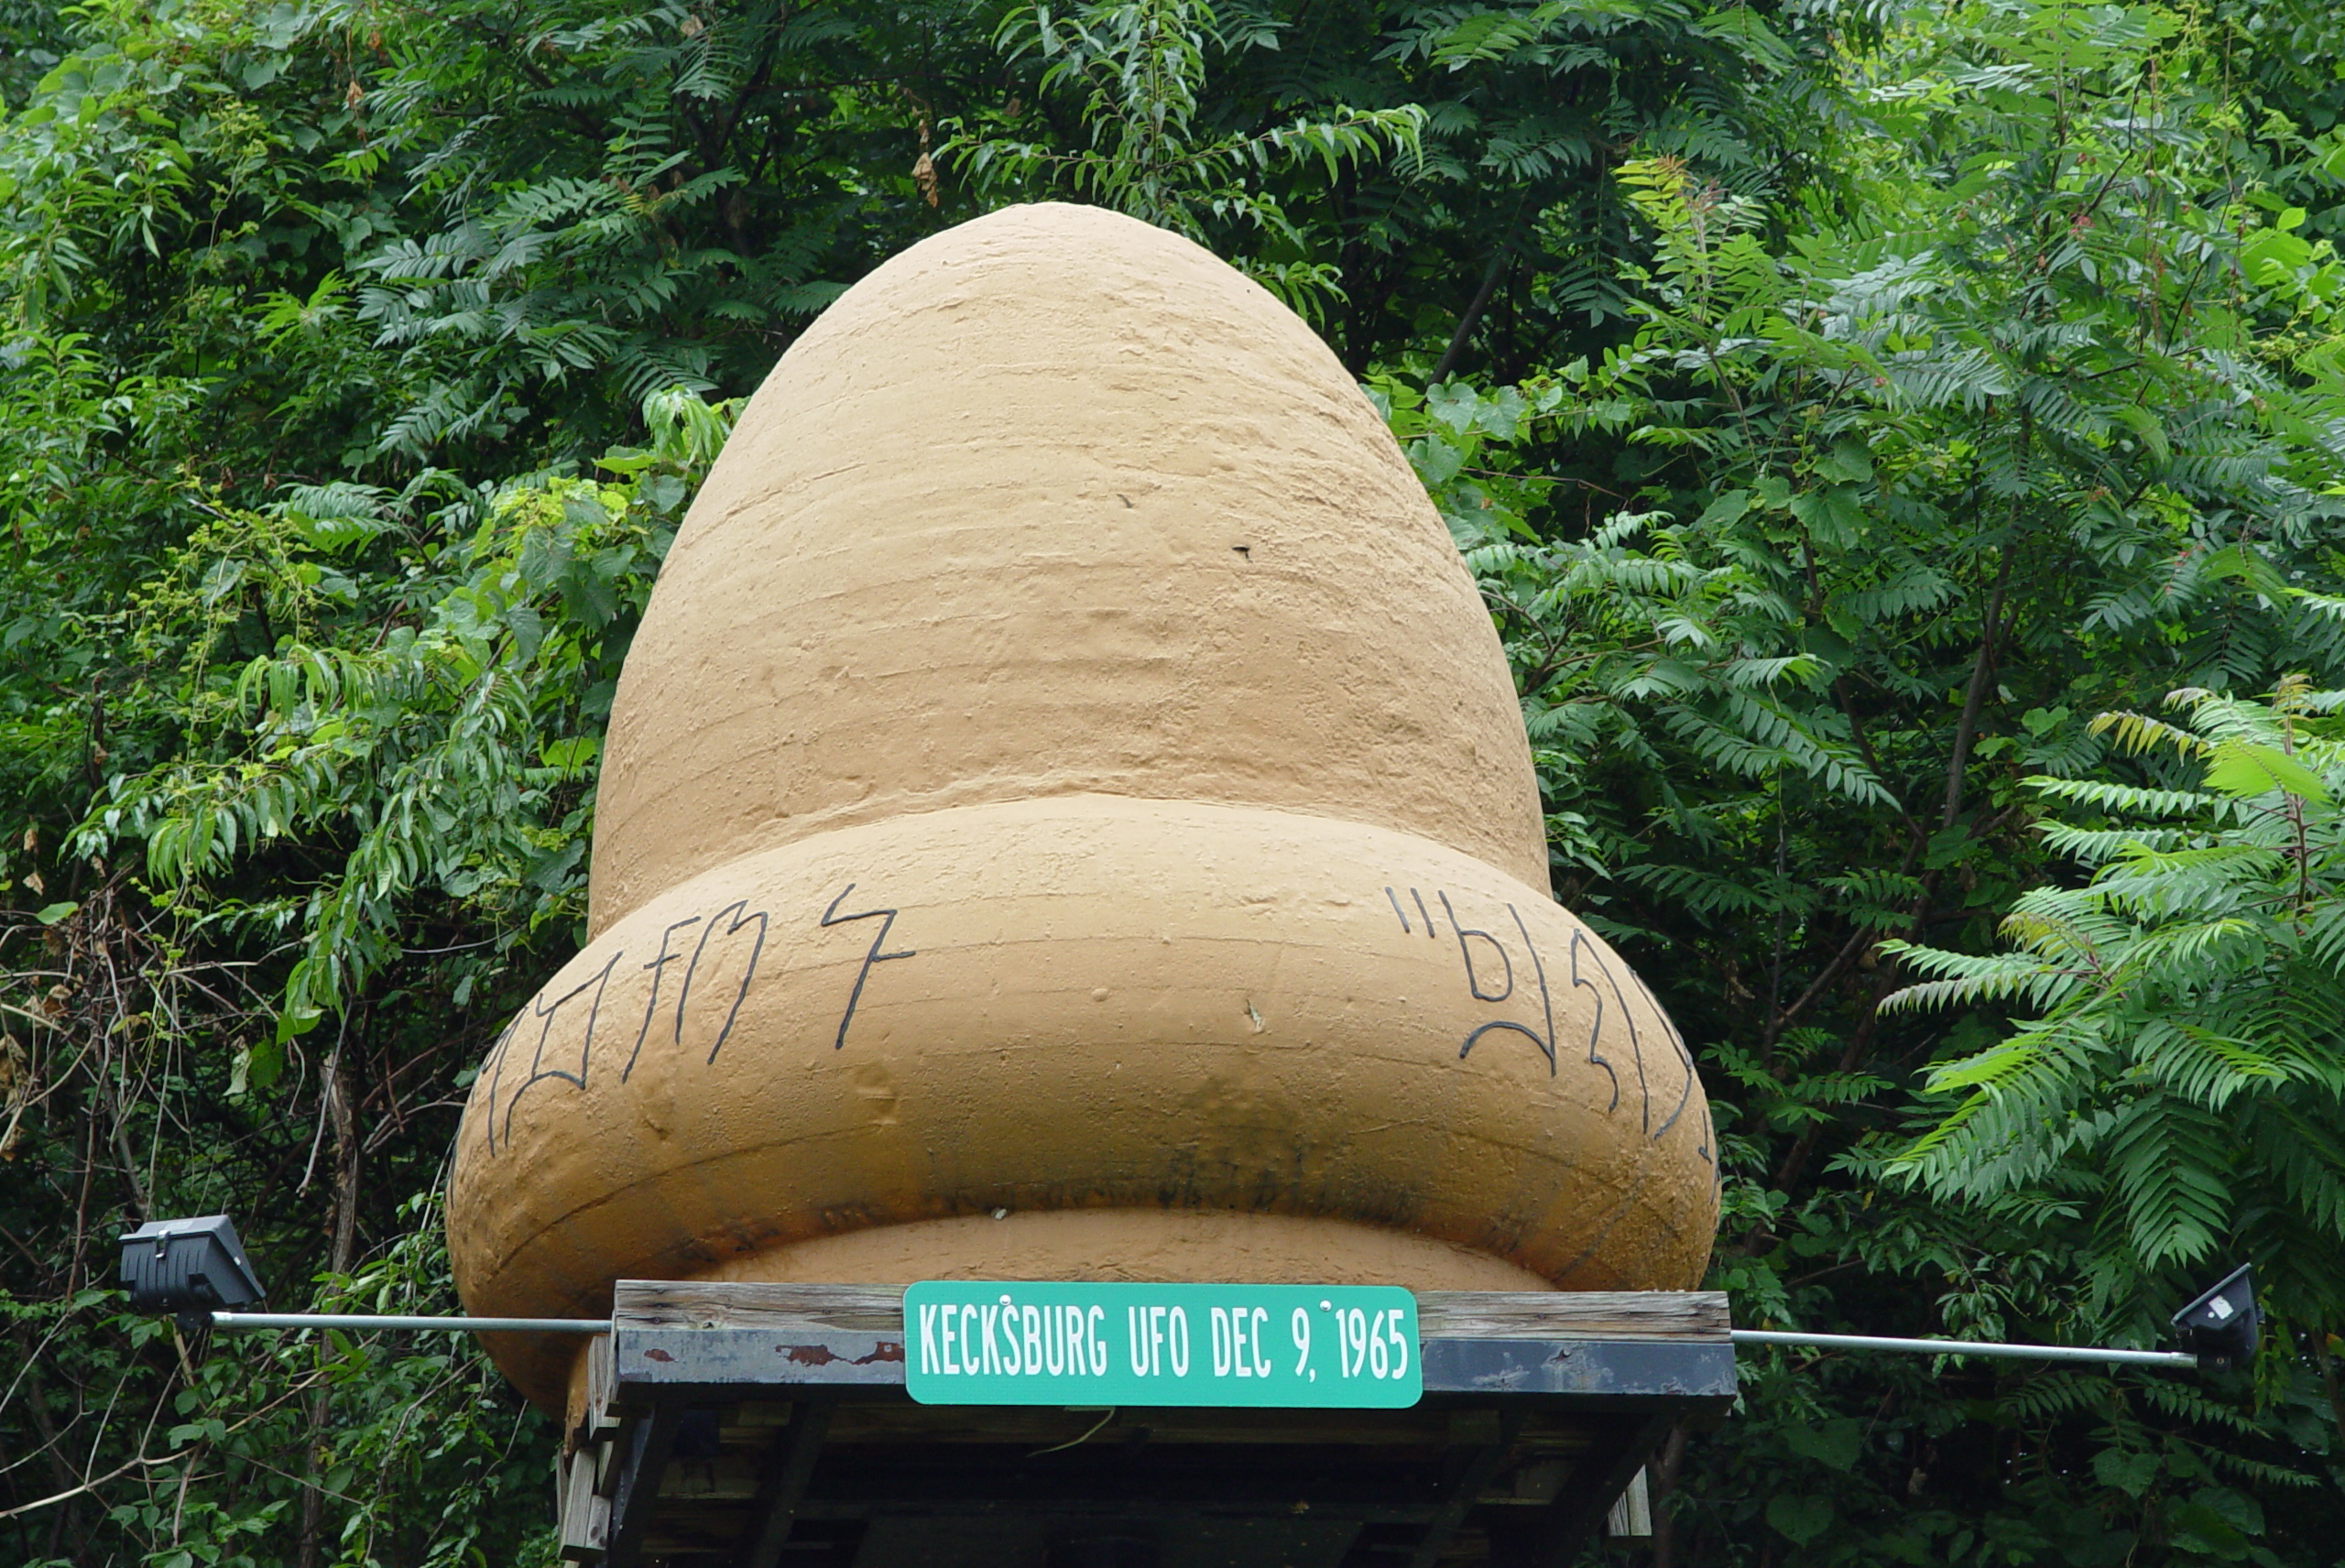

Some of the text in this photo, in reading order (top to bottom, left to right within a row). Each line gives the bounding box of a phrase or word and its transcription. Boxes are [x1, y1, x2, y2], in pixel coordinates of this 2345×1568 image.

[919, 1303, 1408, 1382] KECKSBURG UFO DEC 9, 1965
